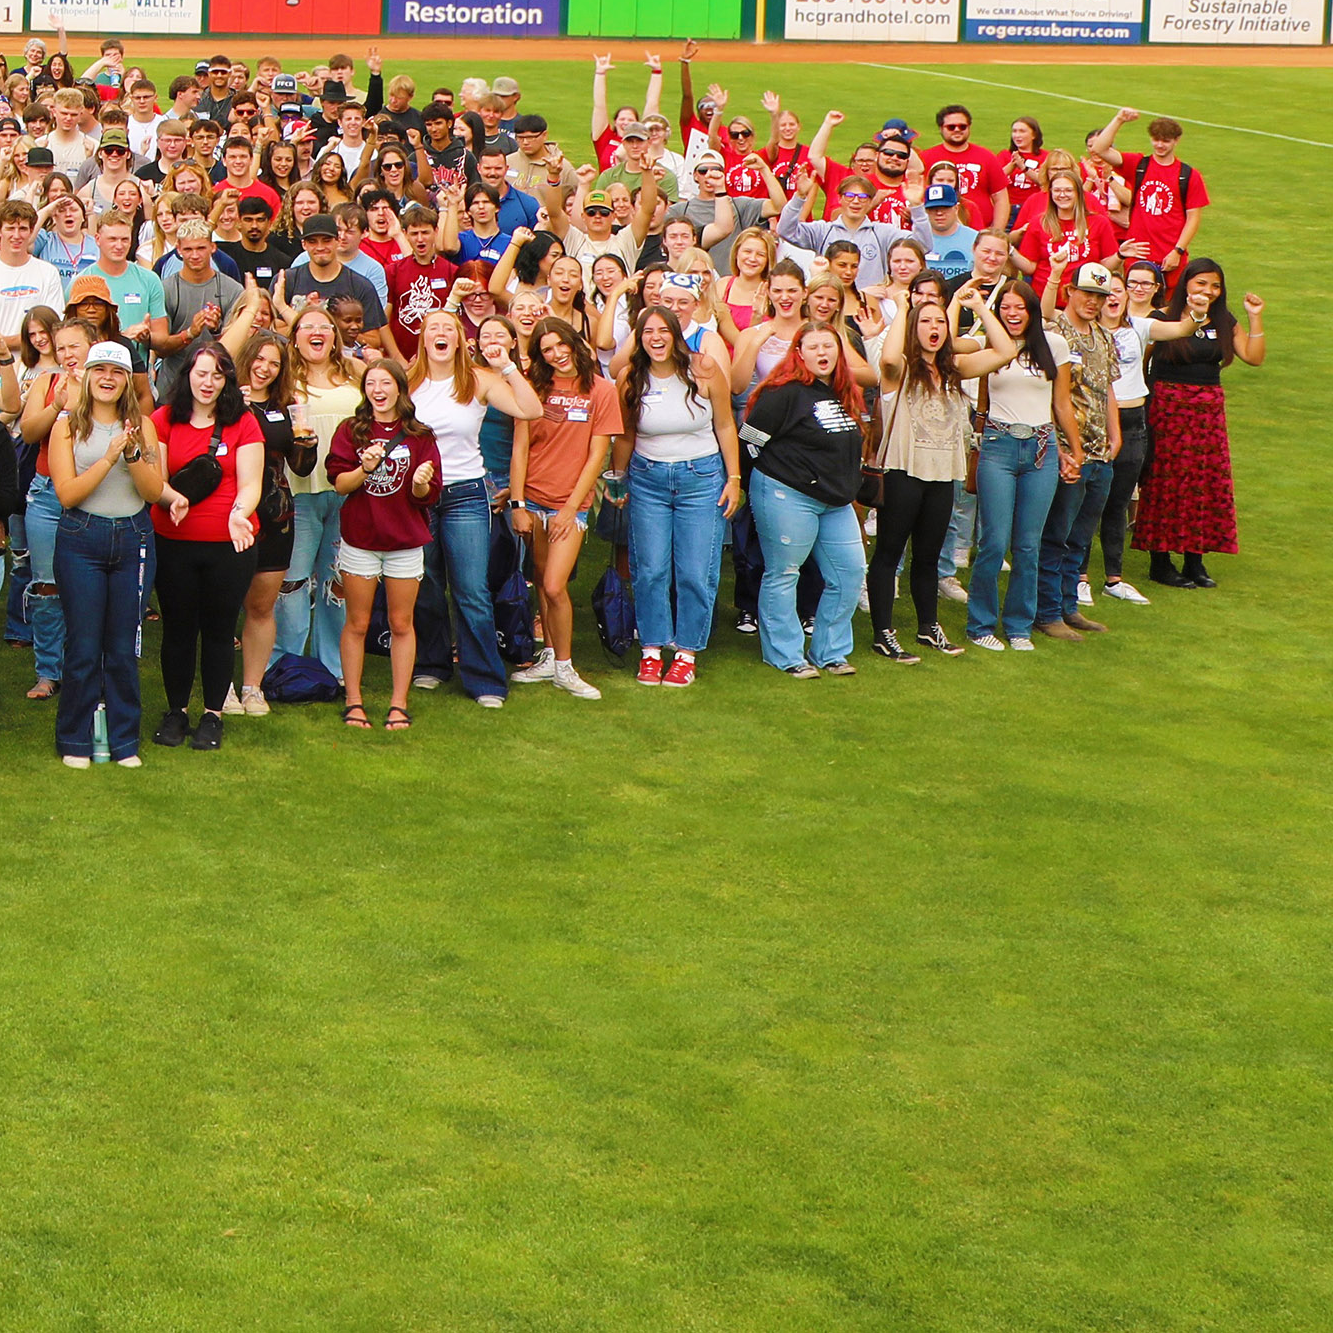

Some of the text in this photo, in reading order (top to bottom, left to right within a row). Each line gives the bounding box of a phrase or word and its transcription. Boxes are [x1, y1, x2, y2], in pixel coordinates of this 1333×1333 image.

[49, 6, 101, 17] Orthopedics
[129, 8, 193, 19] Medical Center
[405, 0, 543, 25] Restoration
[794, 9, 951, 27] hcgrandhotel.com
[976, 7, 1133, 21] We CARE About What You're Driving!
[978, 23, 1130, 40] rogerssubaru.com
[1162, 15, 1312, 34] Forestry Initiative
[547, 395, 591, 412] rangler
